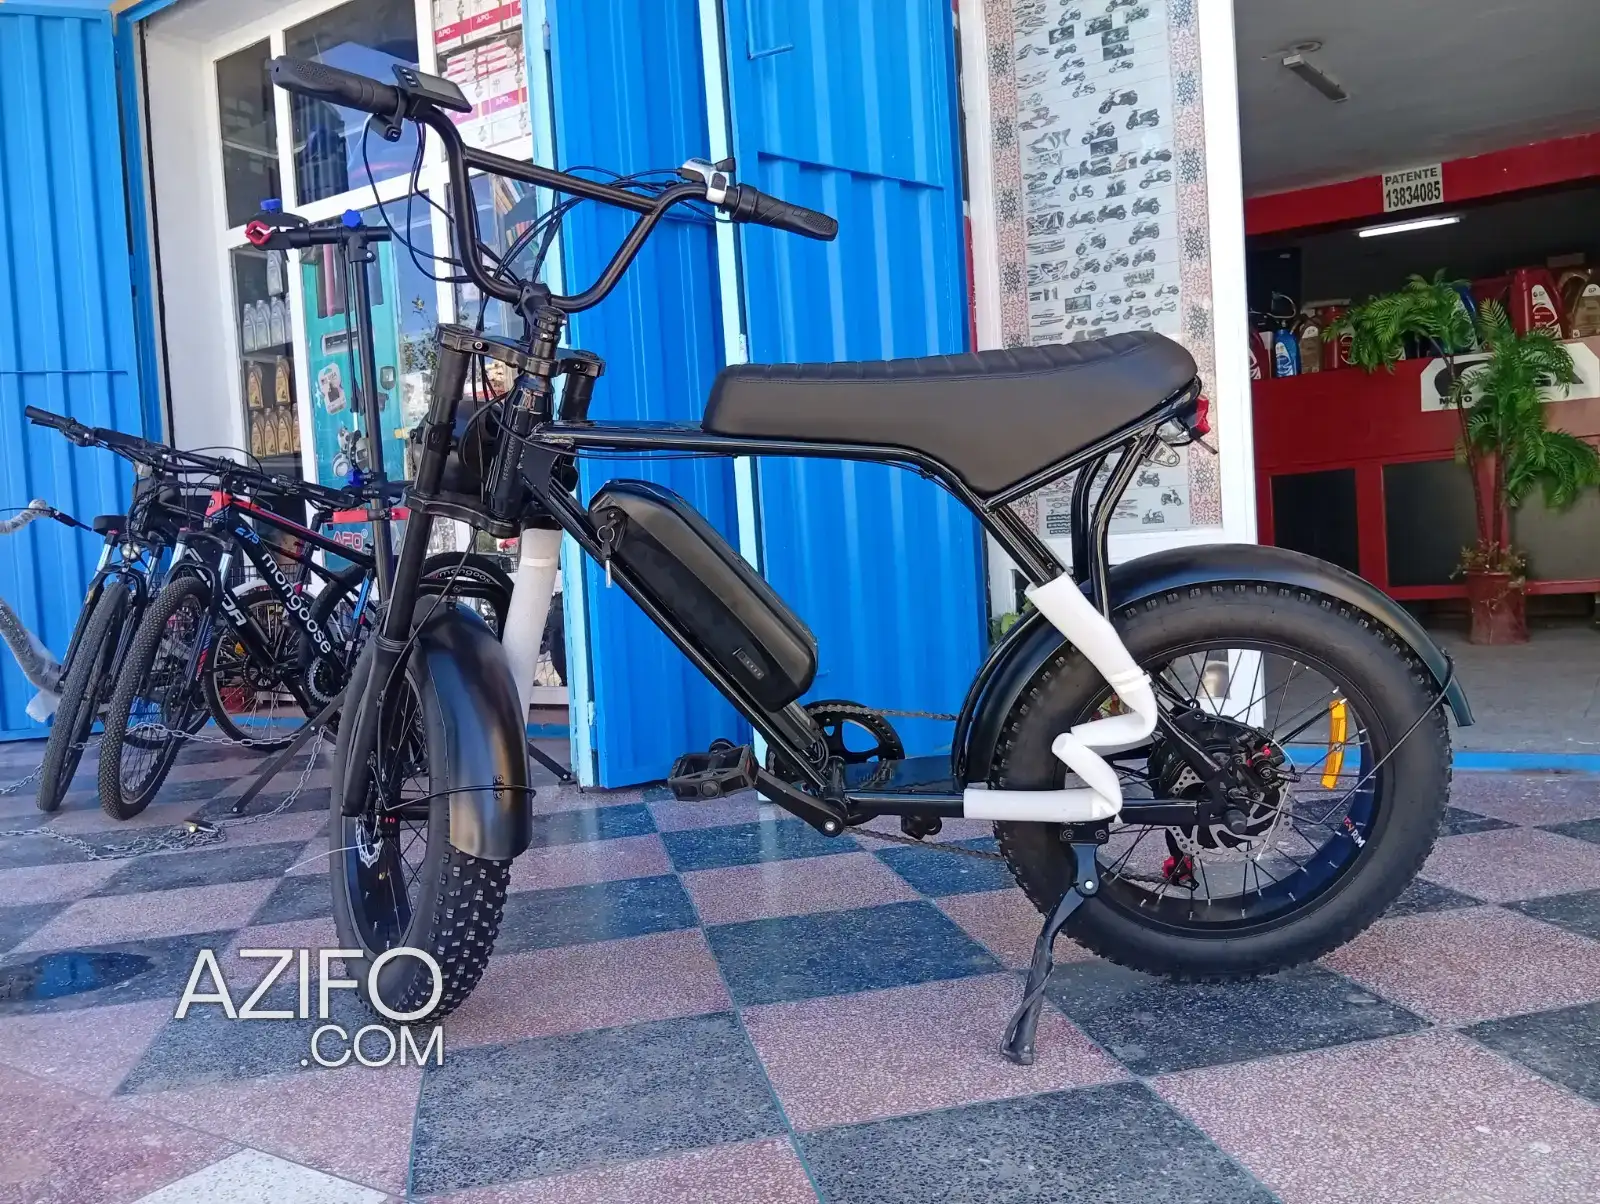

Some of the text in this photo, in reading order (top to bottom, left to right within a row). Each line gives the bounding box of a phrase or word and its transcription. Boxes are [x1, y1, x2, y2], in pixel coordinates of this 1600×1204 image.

[1384, 167, 1438, 186] PATENTE
[1385, 180, 1441, 208] 13834085
[261, 552, 332, 654] mongoose
